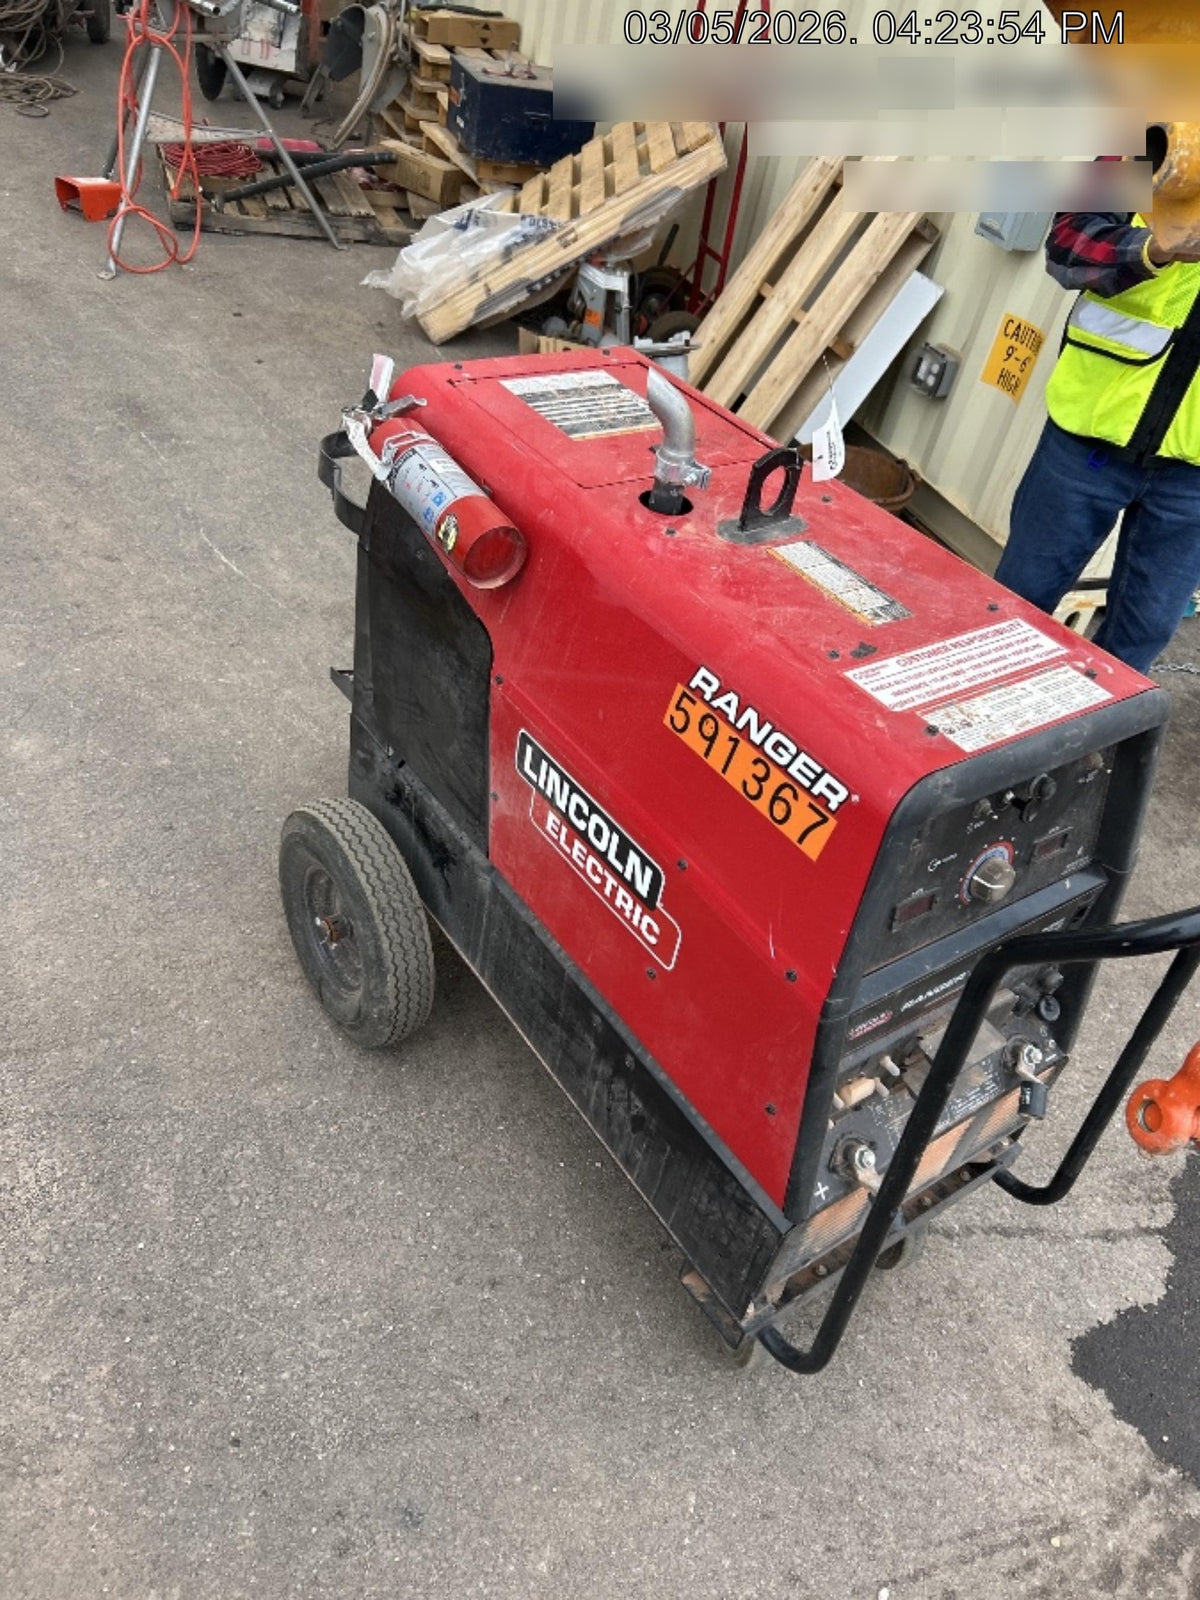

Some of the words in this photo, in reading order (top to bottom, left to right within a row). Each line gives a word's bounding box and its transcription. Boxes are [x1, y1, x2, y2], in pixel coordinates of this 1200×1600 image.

[1003, 318, 1043, 356] CAUTI
[668, 689, 830, 846] 591367
[689, 666, 850, 812] RANGER
[522, 744, 653, 899] LINCOLN
[545, 814, 661, 946] ELECTRIC
